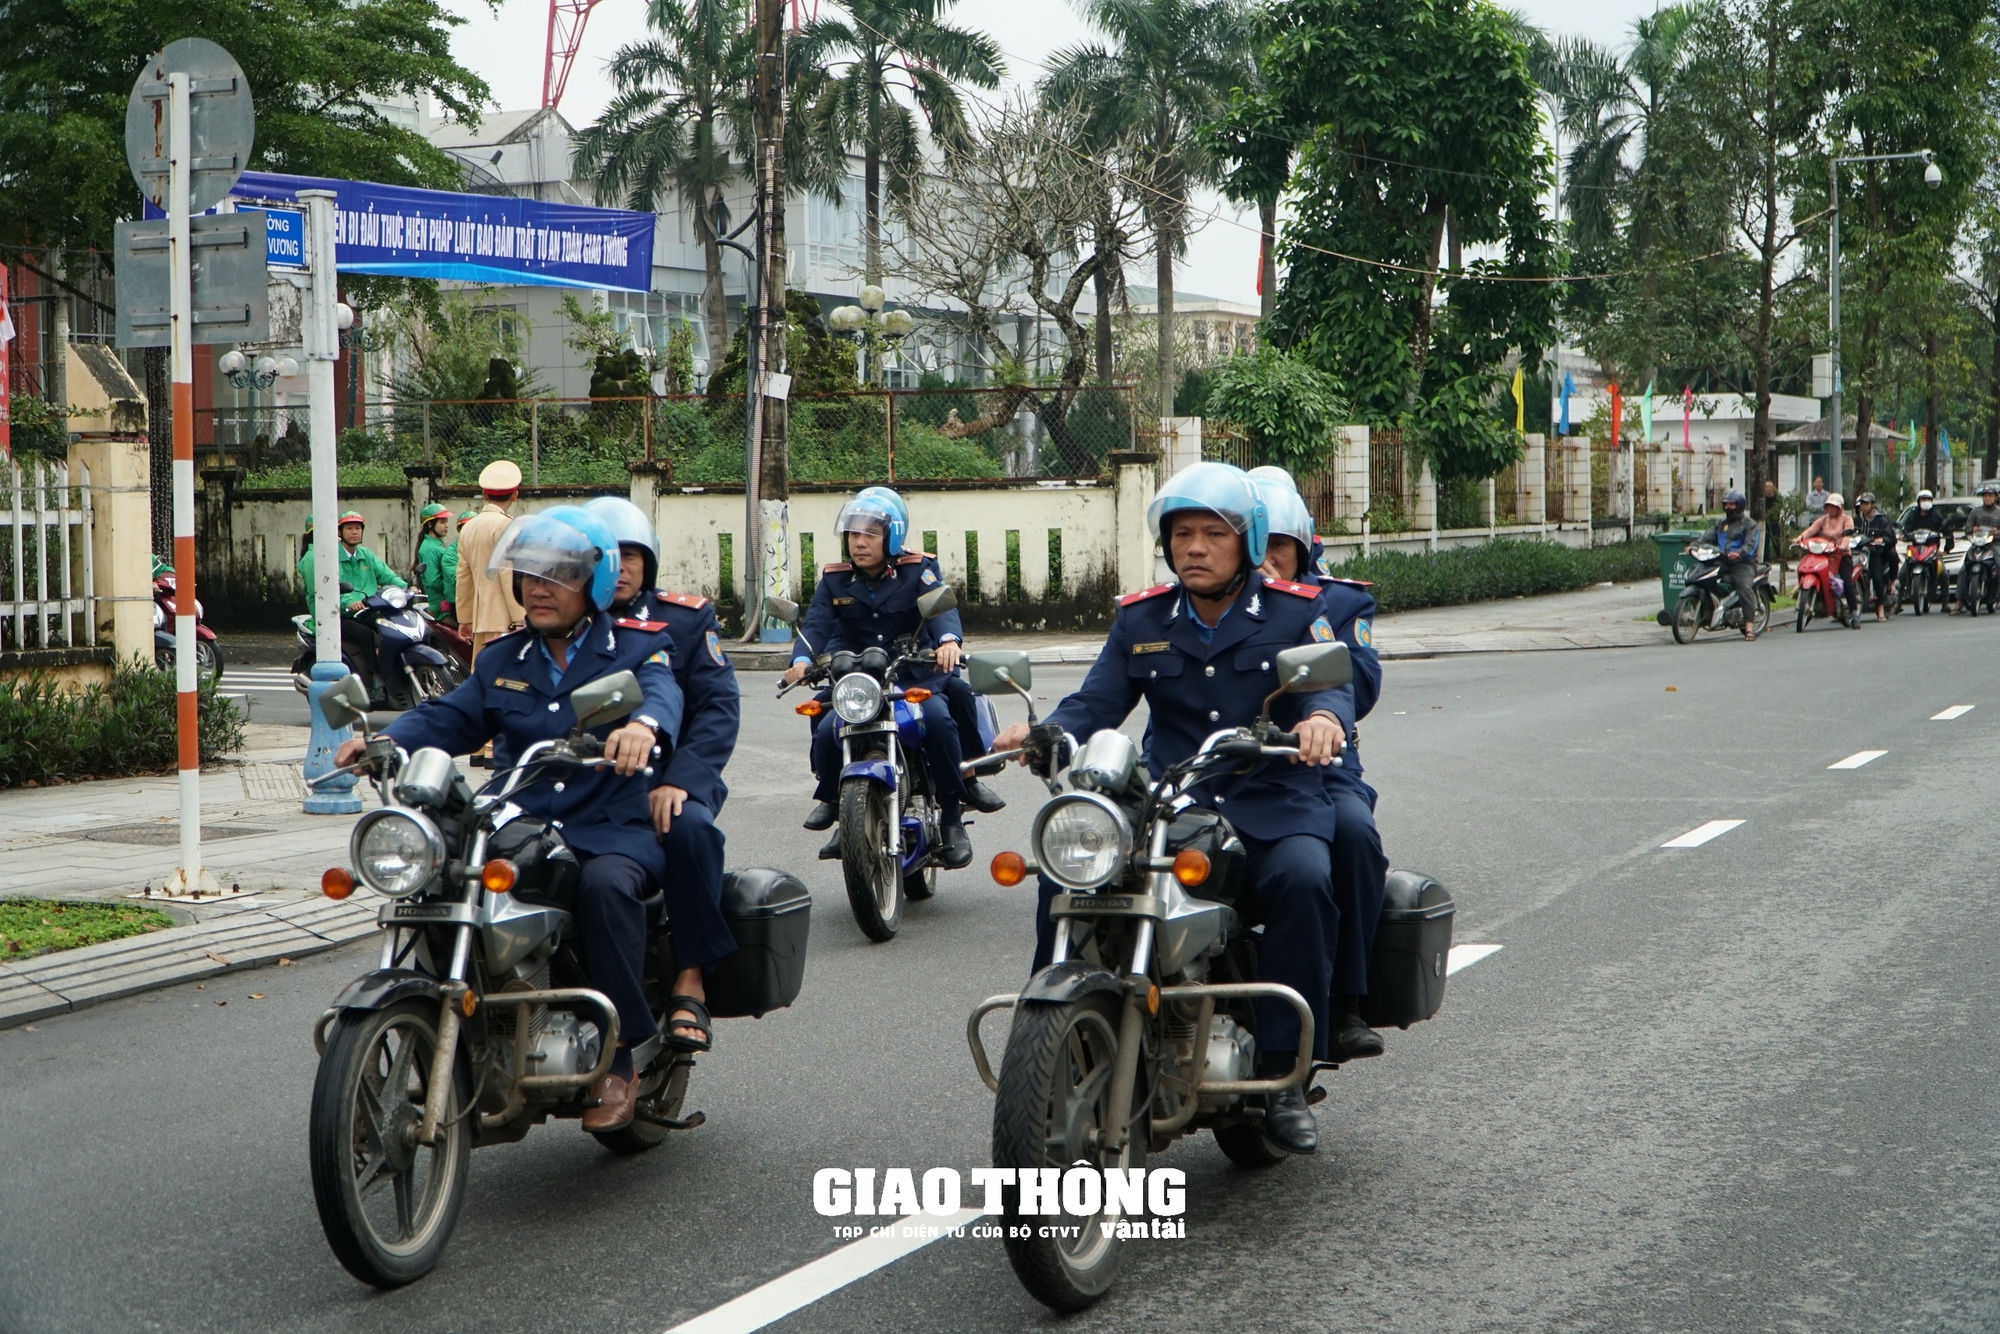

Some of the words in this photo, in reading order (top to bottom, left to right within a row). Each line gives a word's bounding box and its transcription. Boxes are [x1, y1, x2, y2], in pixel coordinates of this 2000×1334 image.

[266, 214, 290, 232] ỜNG
[348, 211, 358, 245] ĐI
[360, 202, 379, 247] ĐẦU
[381, 211, 403, 256] THỰC
[405, 210, 427, 258] HIỆN
[429, 213, 453, 253] PHÁP
[454, 215, 475, 262] LUẬT
[477, 214, 494, 256] BẢO
[495, 216, 514, 258] ĐẢM
[516, 221, 535, 266] TRẬT
[537, 225, 549, 267] TỰ
[548, 230, 561, 261] AN
[562, 225, 582, 263] TOÀN
[583, 232, 602, 265] GIAO
[603, 230, 628, 267] THÔNG
[267, 237, 299, 257] VƯƠNG
[398, 907, 448, 915] HONDA
[1074, 900, 1128, 908] HONDA
